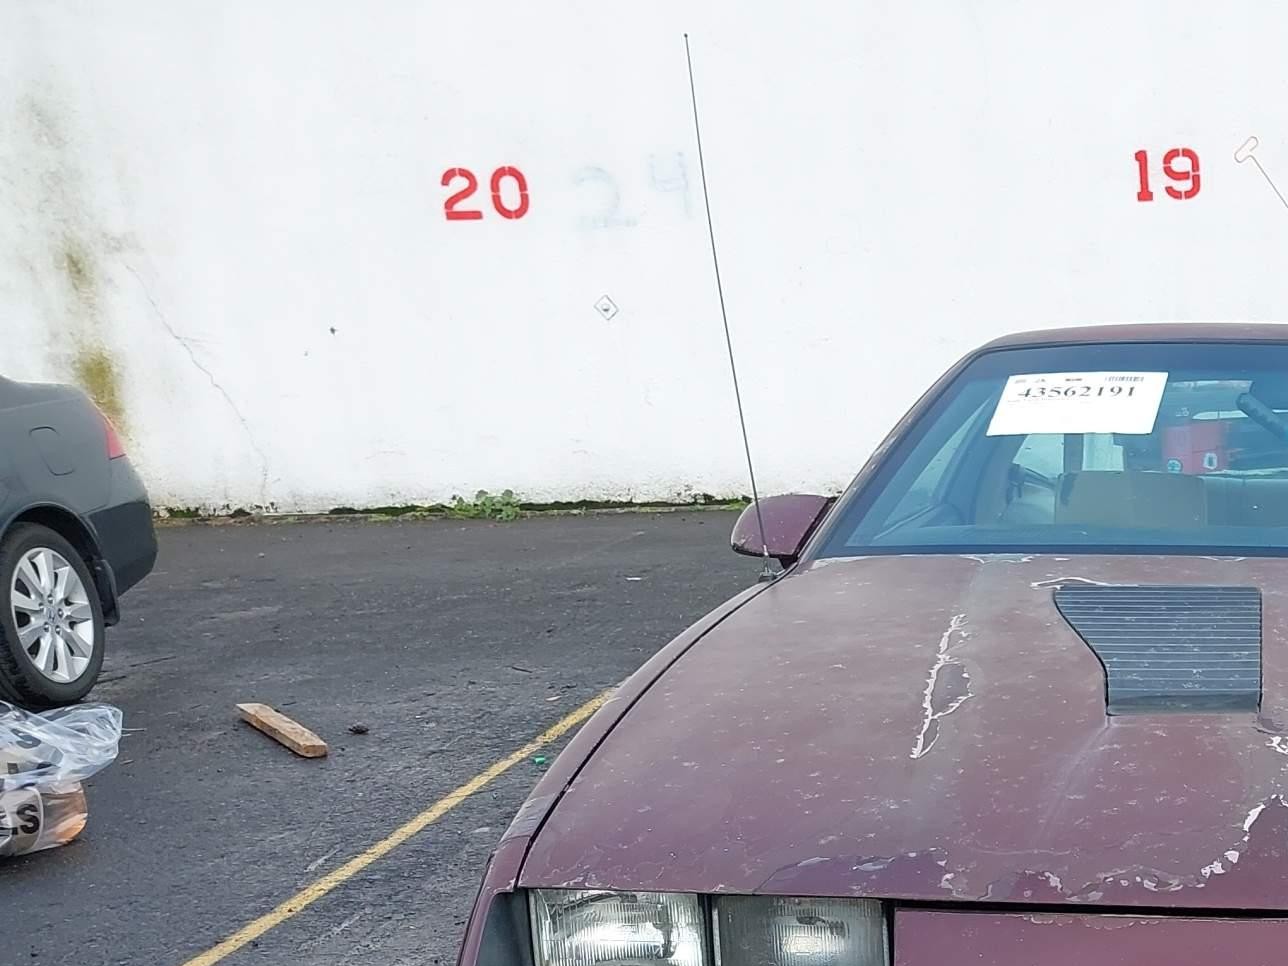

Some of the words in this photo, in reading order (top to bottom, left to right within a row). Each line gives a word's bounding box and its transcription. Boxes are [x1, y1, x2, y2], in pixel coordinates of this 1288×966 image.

[441, 165, 530, 222] 20
[1134, 147, 1201, 203] 19
[1017, 385, 1137, 399] 43562191
